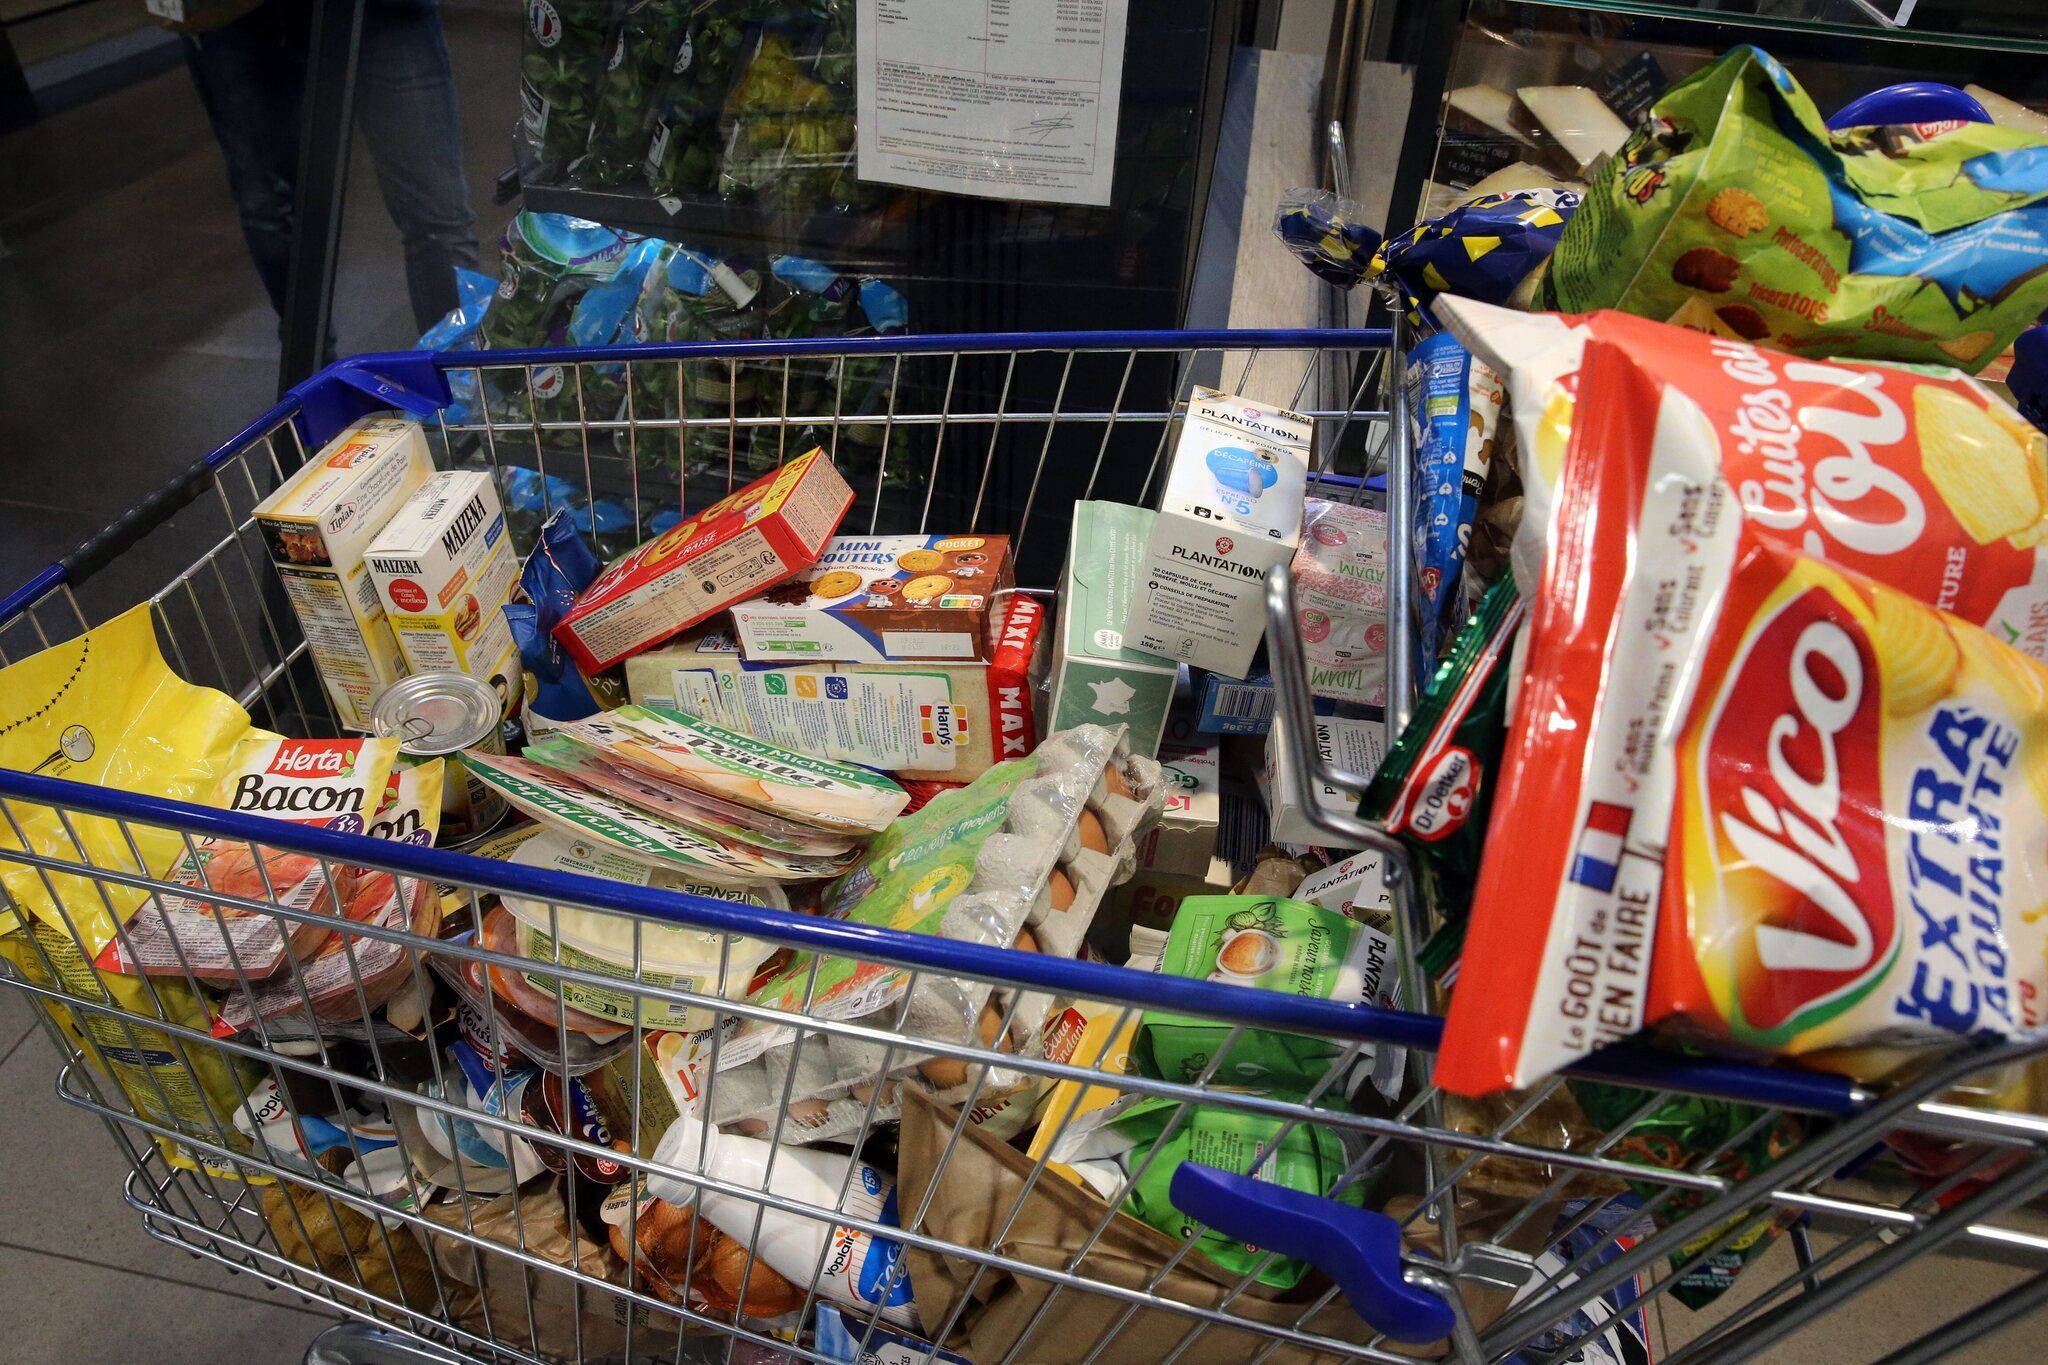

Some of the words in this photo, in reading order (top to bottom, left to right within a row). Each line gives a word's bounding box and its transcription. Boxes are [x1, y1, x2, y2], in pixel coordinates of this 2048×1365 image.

[1201, 408, 1299, 441] PLANTATION
[1245, 439, 1293, 456] SAVOUREUX
[329, 505, 354, 531] Tipiak
[441, 494, 487, 561] MAIZENA
[837, 541, 882, 552] MINI
[938, 538, 981, 550] POCKET
[1172, 545, 1265, 581] PLANTATION
[372, 559, 423, 574] MAIZENA
[1161, 569, 1189, 582] CAPSULES
[1199, 579, 1213, 588] CAFÉ
[1180, 580, 1199, 590] MOULU
[1160, 585, 1185, 597] CONSEILS
[1194, 595, 1230, 609] PRÉPARATION
[1001, 599, 1036, 651] MAXI
[997, 687, 1027, 760] MAX
[273, 746, 342, 771] Herta
[691, 721, 765, 755] Fleury
[766, 748, 857, 780] Michon
[1316, 724, 1336, 795] PTATION
[230, 774, 365, 812] Bacon
[488, 771, 578, 815] Michon
[1721, 621, 1874, 972] Vico
[578, 811, 669, 853] Fleury
[1305, 862, 1377, 897] PLANTATION
[1896, 708, 1990, 1034] EXTRA
[1972, 724, 2020, 1028] AQUANTE
[1305, 918, 1330, 963] Saveur
[1611, 885, 1650, 976] FAIRE
[1561, 936, 1599, 1023] GOÛT
[1043, 1020, 1072, 1060] Extra
[1053, 1018, 1087, 1065] ondant
[824, 1236, 854, 1277] Yoplait
